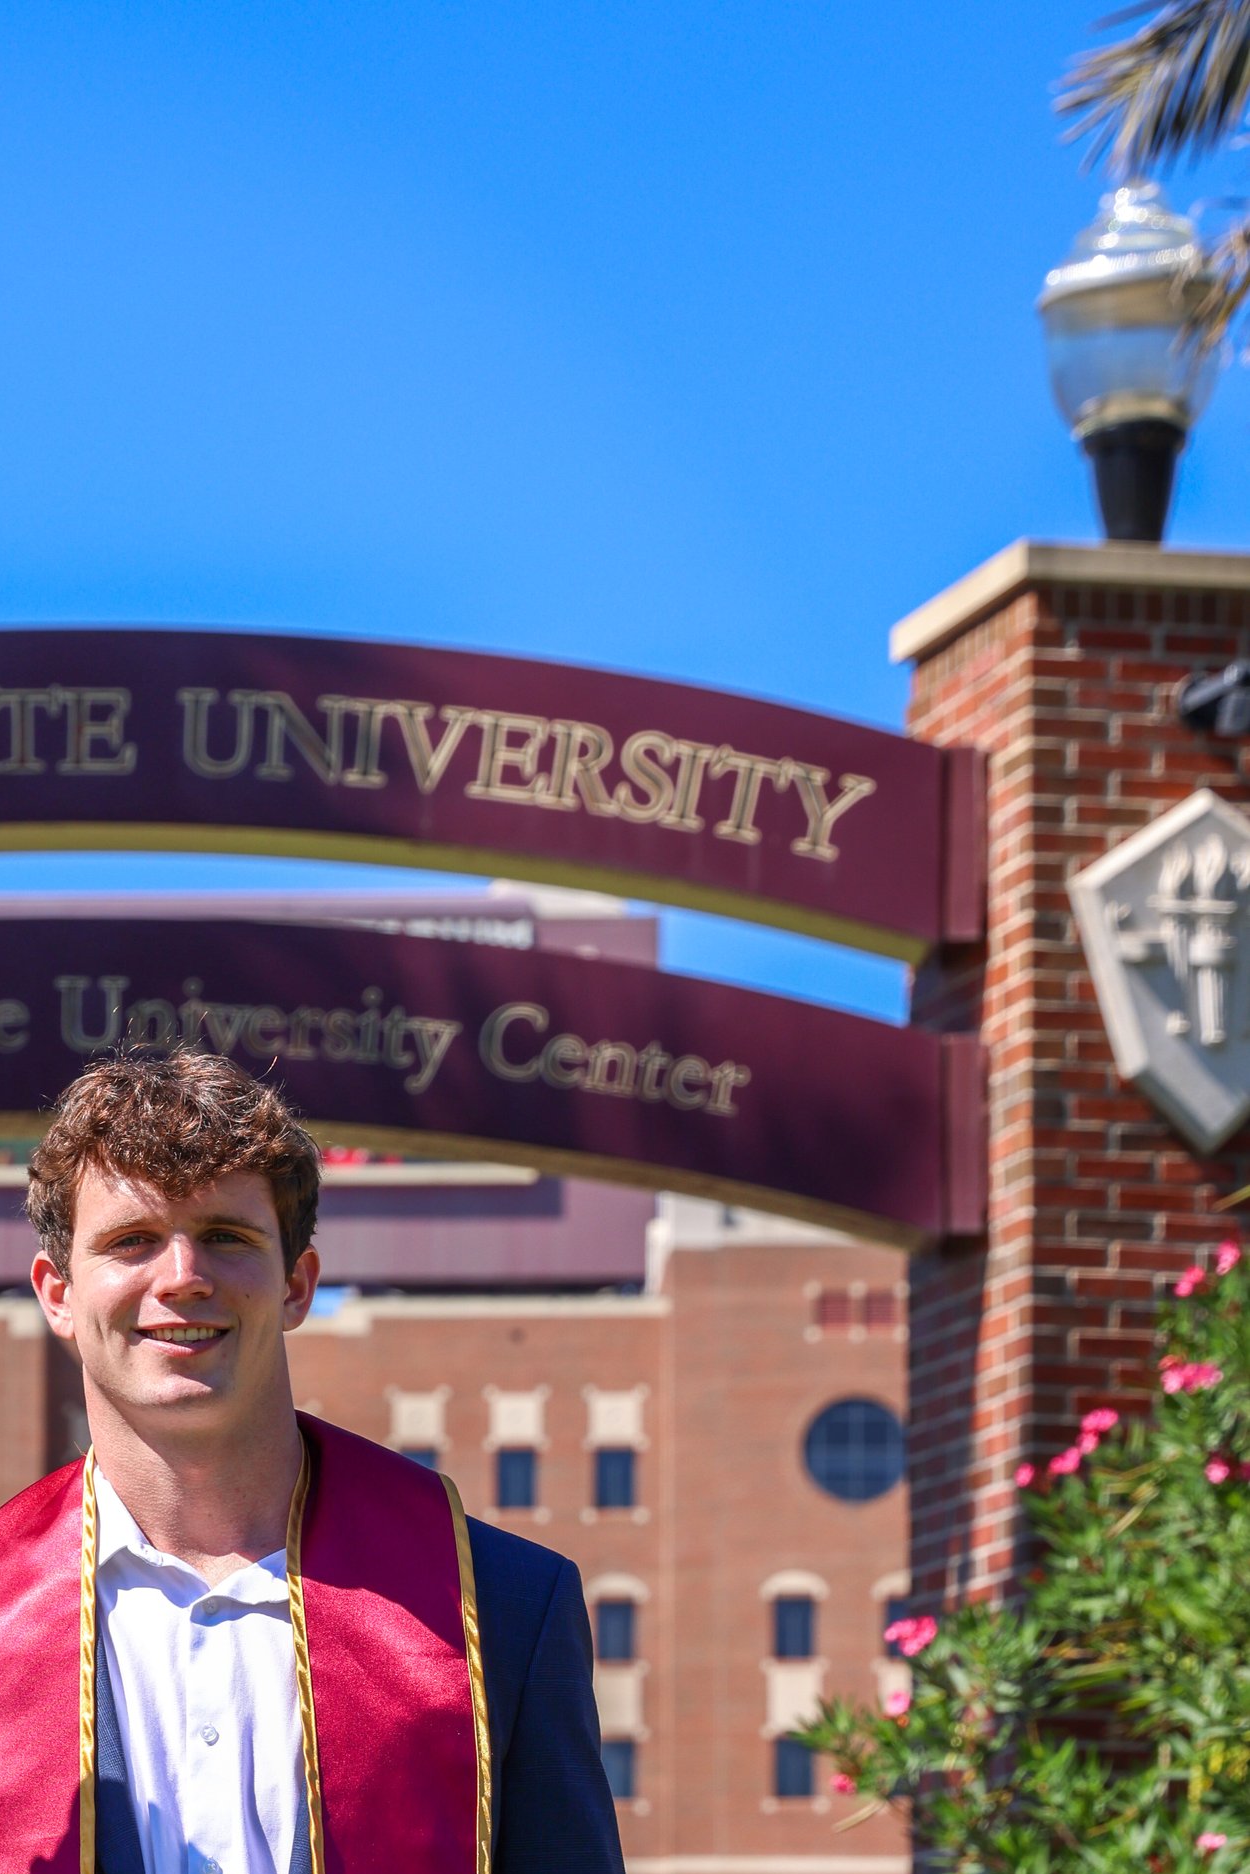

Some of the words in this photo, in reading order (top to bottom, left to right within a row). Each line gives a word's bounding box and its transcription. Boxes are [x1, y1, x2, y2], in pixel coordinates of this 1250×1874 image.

[177, 686, 877, 863] UNIVERSITY
[54, 974, 463, 1096] University
[478, 1002, 752, 1119] Center
